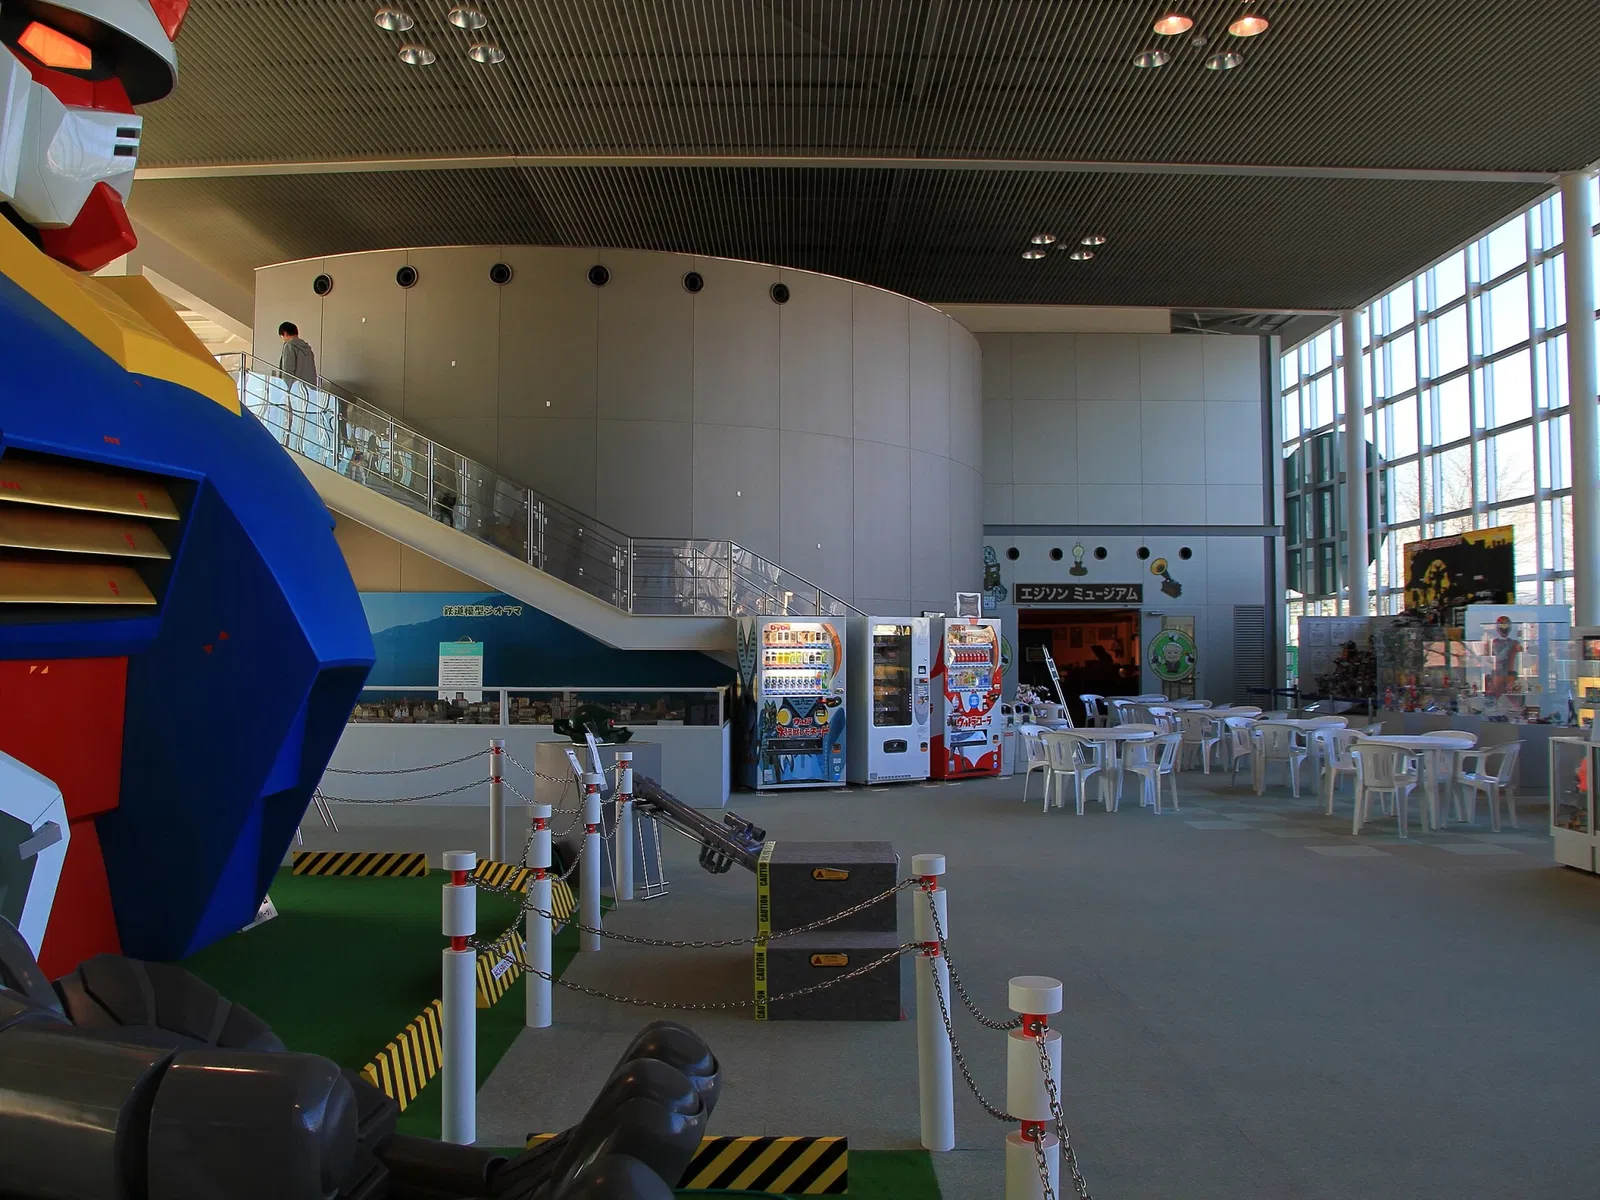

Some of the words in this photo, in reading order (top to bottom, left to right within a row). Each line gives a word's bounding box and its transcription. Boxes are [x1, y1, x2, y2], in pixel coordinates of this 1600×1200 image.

[1021, 586, 1069, 601] エジソン
[1073, 586, 1138, 601] ミュージアム
[442, 604, 522, 617] 鉄道模型ジオラマ
[955, 715, 992, 729] ウルトラコーラ
[760, 894, 768, 922] CAUTION
[756, 952, 765, 981] CAUTION
[757, 990, 766, 1019] CAUON
